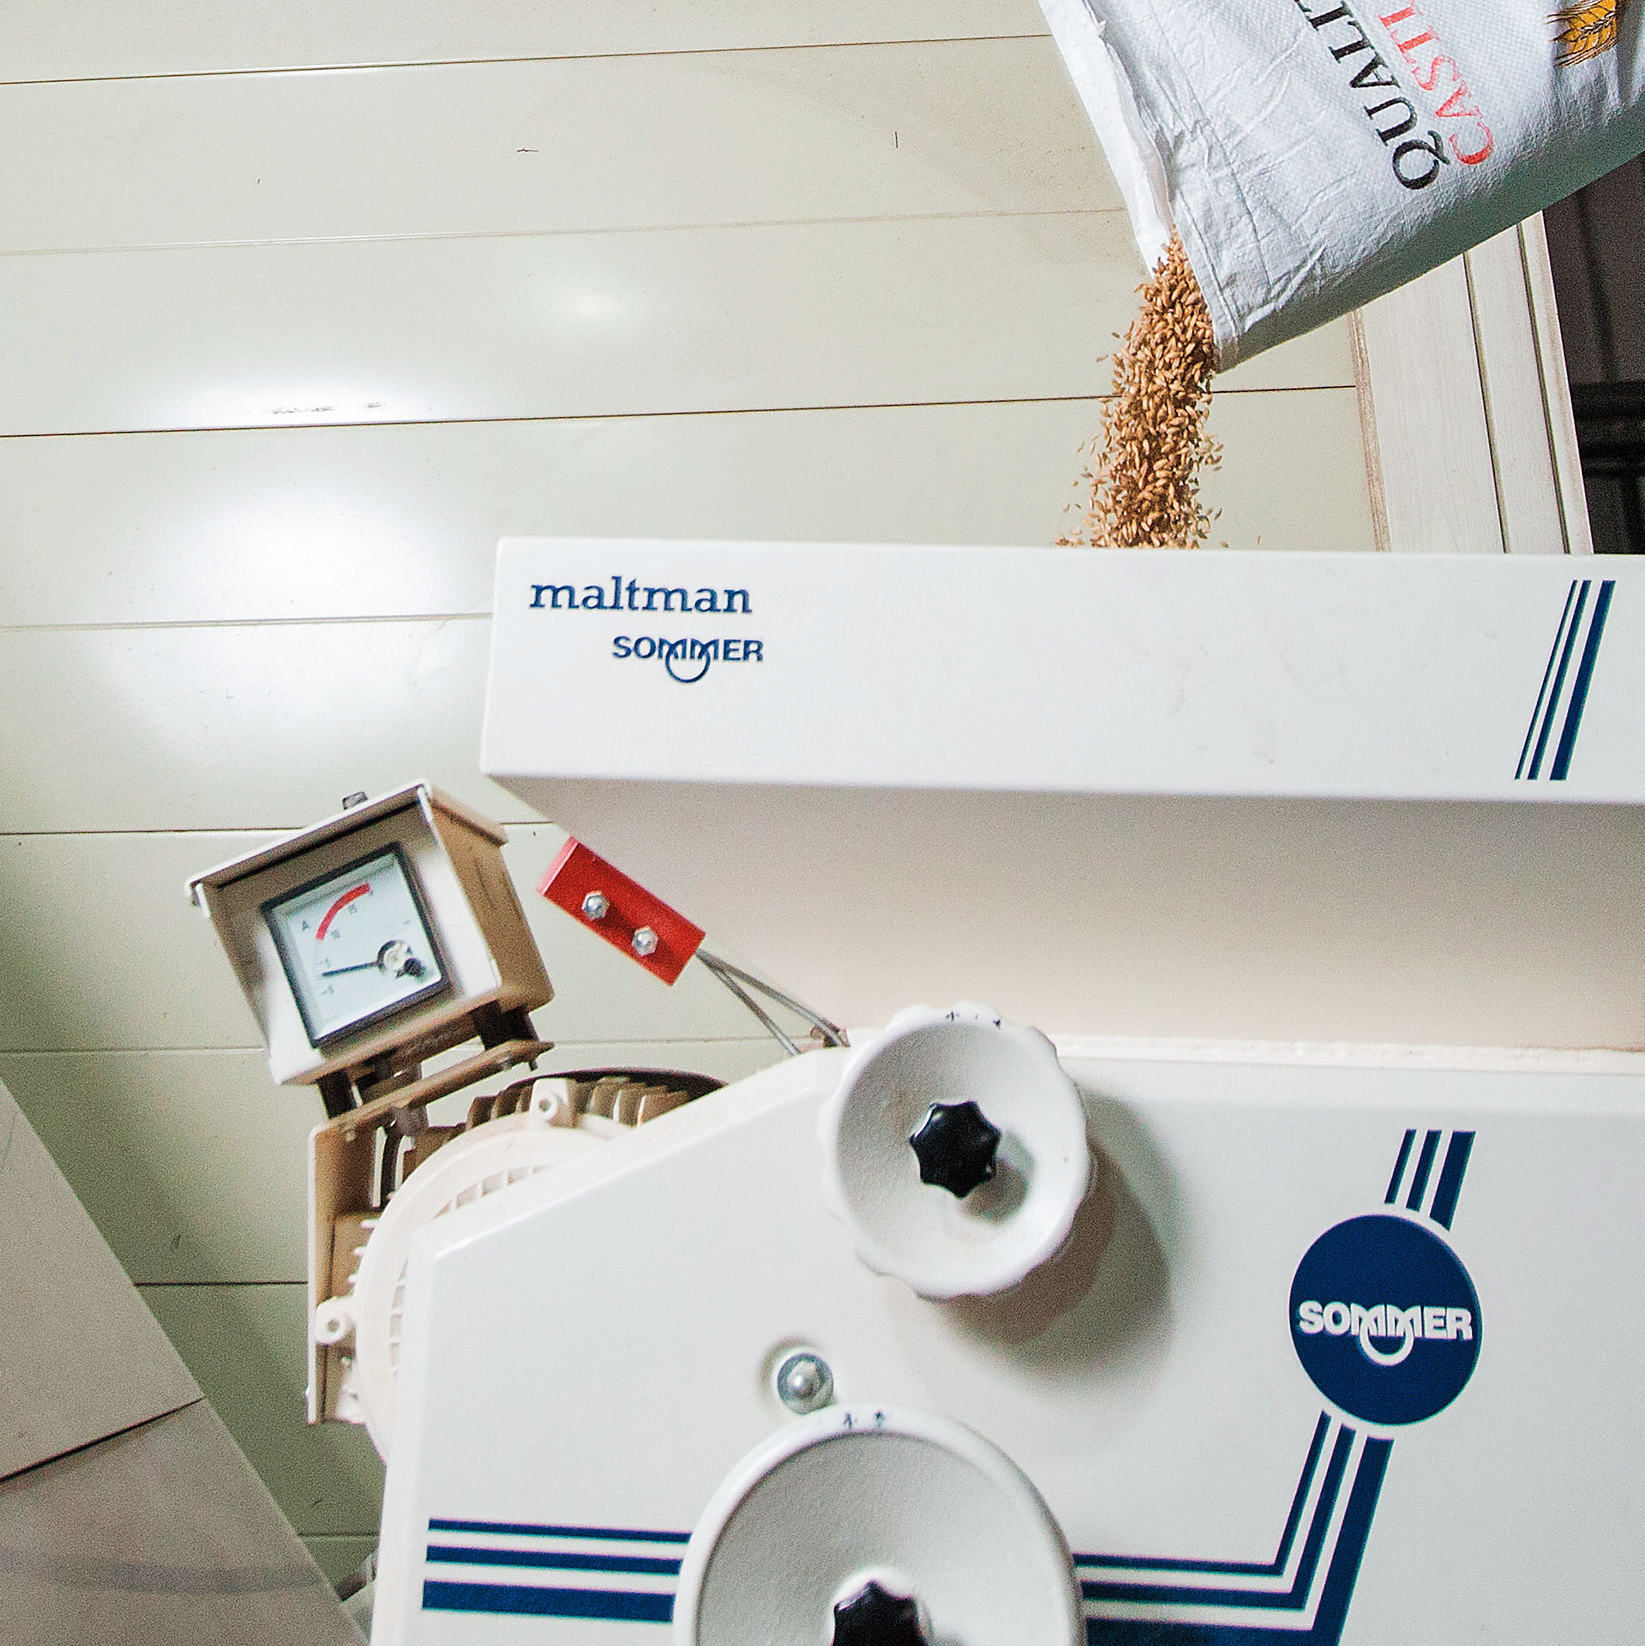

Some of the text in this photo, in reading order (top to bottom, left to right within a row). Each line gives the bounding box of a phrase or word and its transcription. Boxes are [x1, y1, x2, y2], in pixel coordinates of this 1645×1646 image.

[529, 575, 753, 613] maltman
[612, 635, 764, 683] SOMMER
[1299, 1300, 1473, 1367] SOMMER
